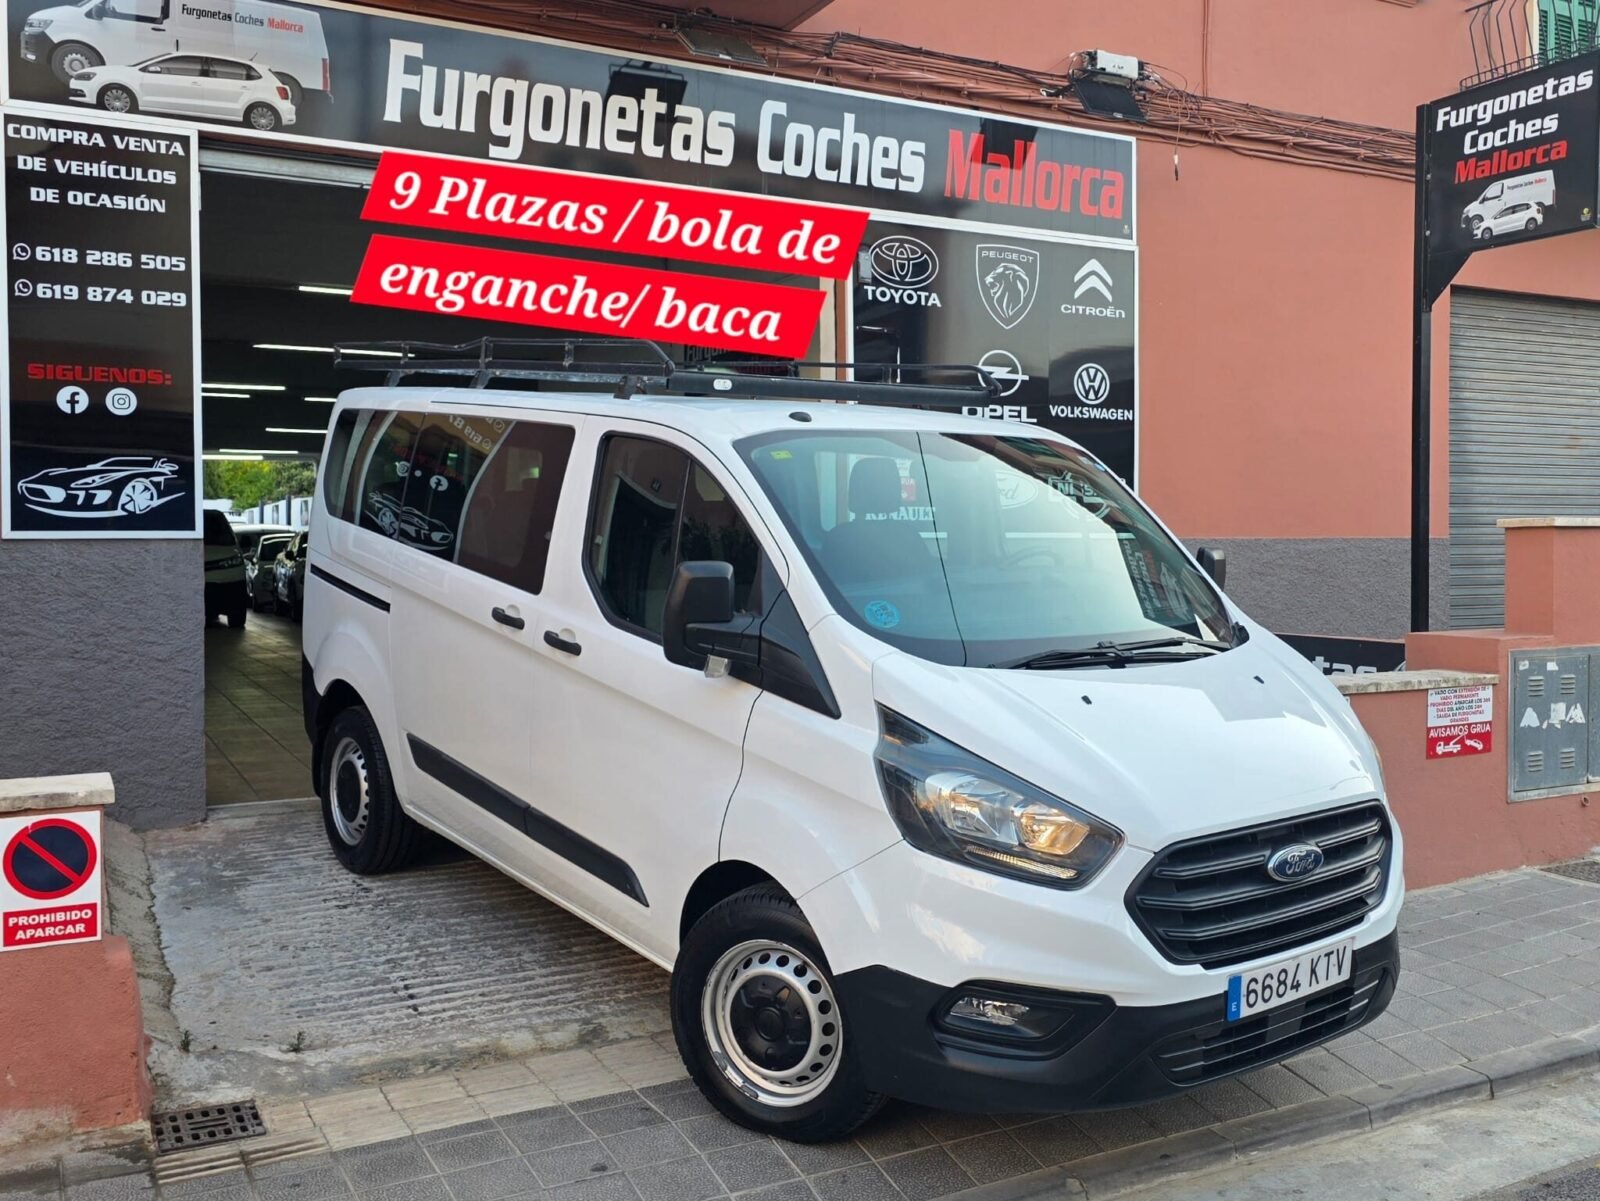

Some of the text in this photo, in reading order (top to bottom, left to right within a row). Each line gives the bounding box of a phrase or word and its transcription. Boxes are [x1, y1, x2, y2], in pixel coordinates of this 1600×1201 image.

[181, 4, 304, 33] Furgonetas Coches Mallorca
[1436, 69, 1594, 132] Furgonetas
[7, 123, 186, 157] COMPRA VENTA
[383, 38, 1124, 220] Furgonetas Coches Mallorca
[1463, 113, 1559, 155] Coches
[17, 154, 177, 185] DE VEHÍCULOS
[1454, 140, 1568, 185] Mallorca
[30, 187, 166, 213] DE OCASIÓN
[35, 245, 187, 272] 618 286 505
[981, 249, 1035, 264] PEUGEOT
[36, 283, 187, 307] 619 874 029
[864, 285, 942, 308] TOYOTA
[27, 363, 173, 386] SIGUENOS:
[961, 404, 1038, 423] OPEL
[1049, 404, 1134, 421] VOLKSWAGEN
[1429, 723, 1491, 738] AVISAMOS GRUA
[1286, 850, 1316, 876] Ford
[8, 909, 92, 927] PROHIBIDO
[15, 923, 86, 940] APARCAR
[1246, 945, 1348, 1009] 6684 KTV
